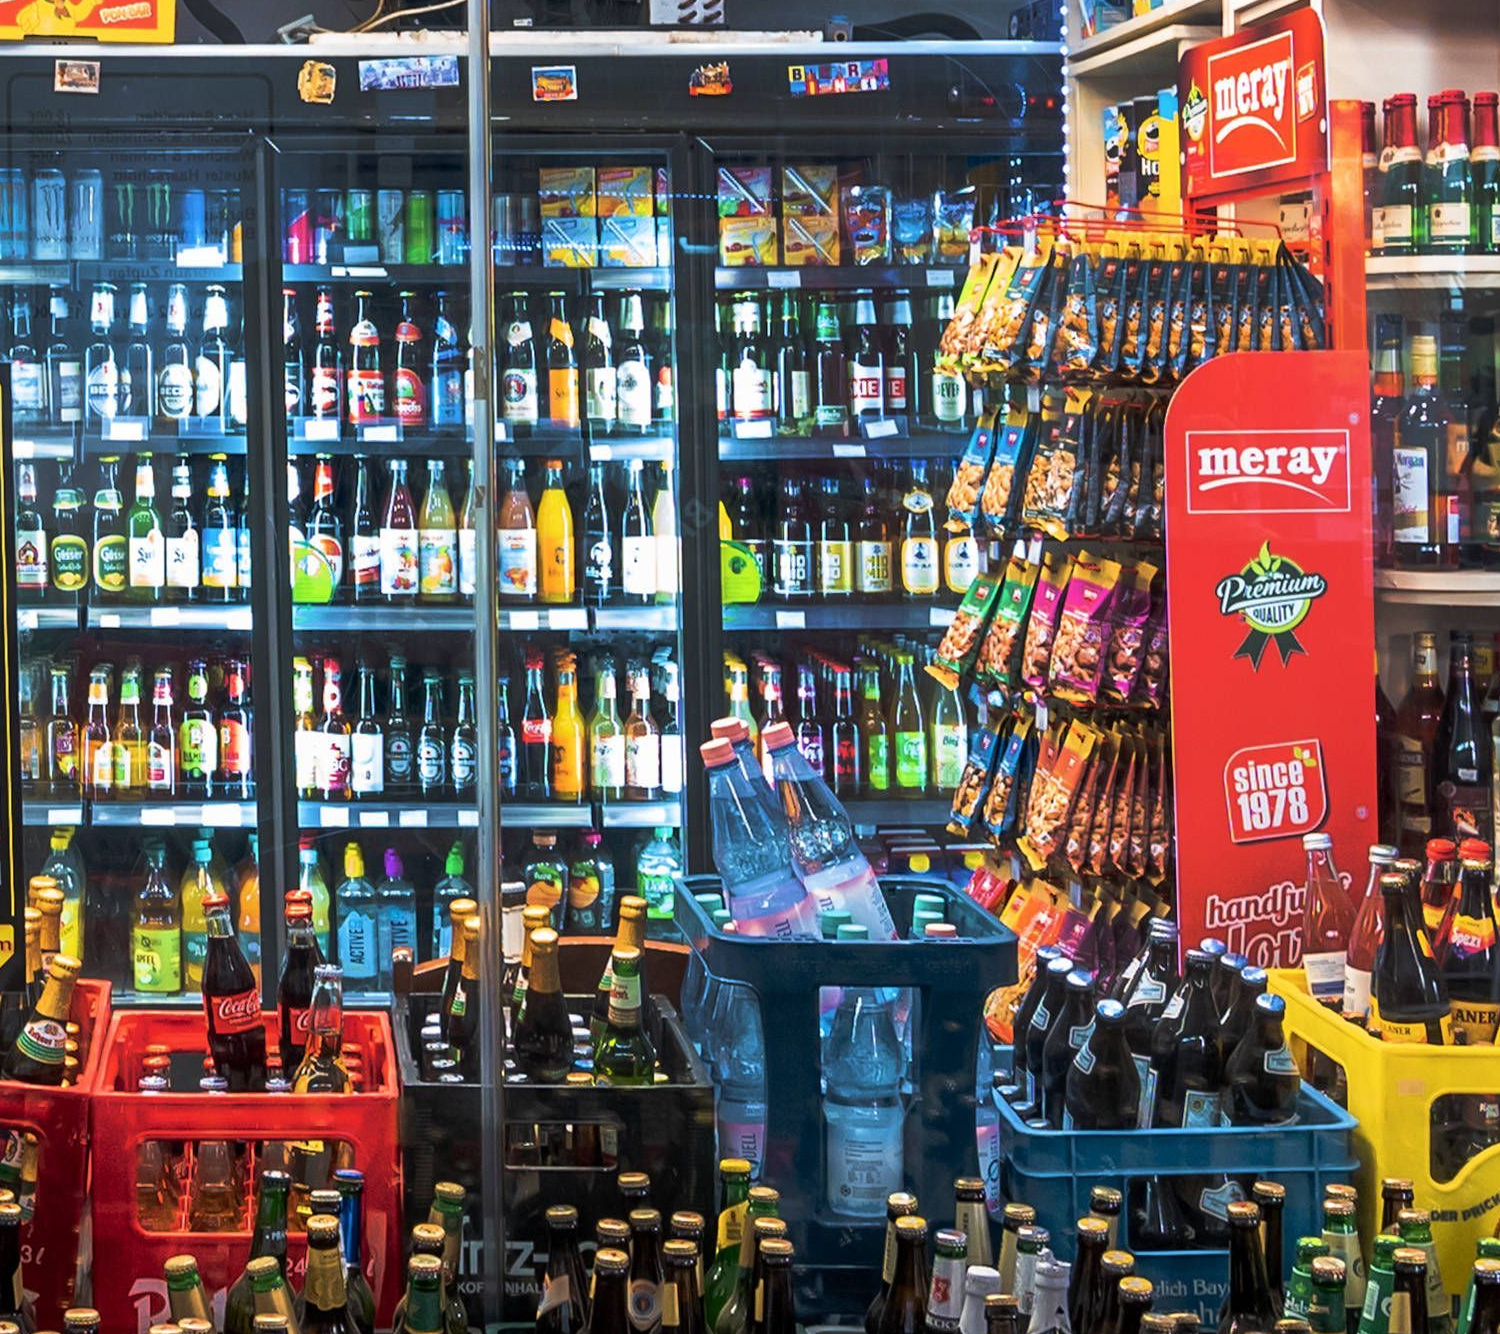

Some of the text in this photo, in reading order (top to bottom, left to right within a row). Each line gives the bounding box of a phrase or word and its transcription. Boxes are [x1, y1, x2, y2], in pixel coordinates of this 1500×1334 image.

[1214, 58, 1287, 122] meray
[1199, 442, 1338, 485] meray
[1217, 571, 1324, 614] Premium
[1253, 601, 1295, 623] QUALITY
[1233, 761, 1305, 793] since
[1238, 789, 1310, 831] 1978
